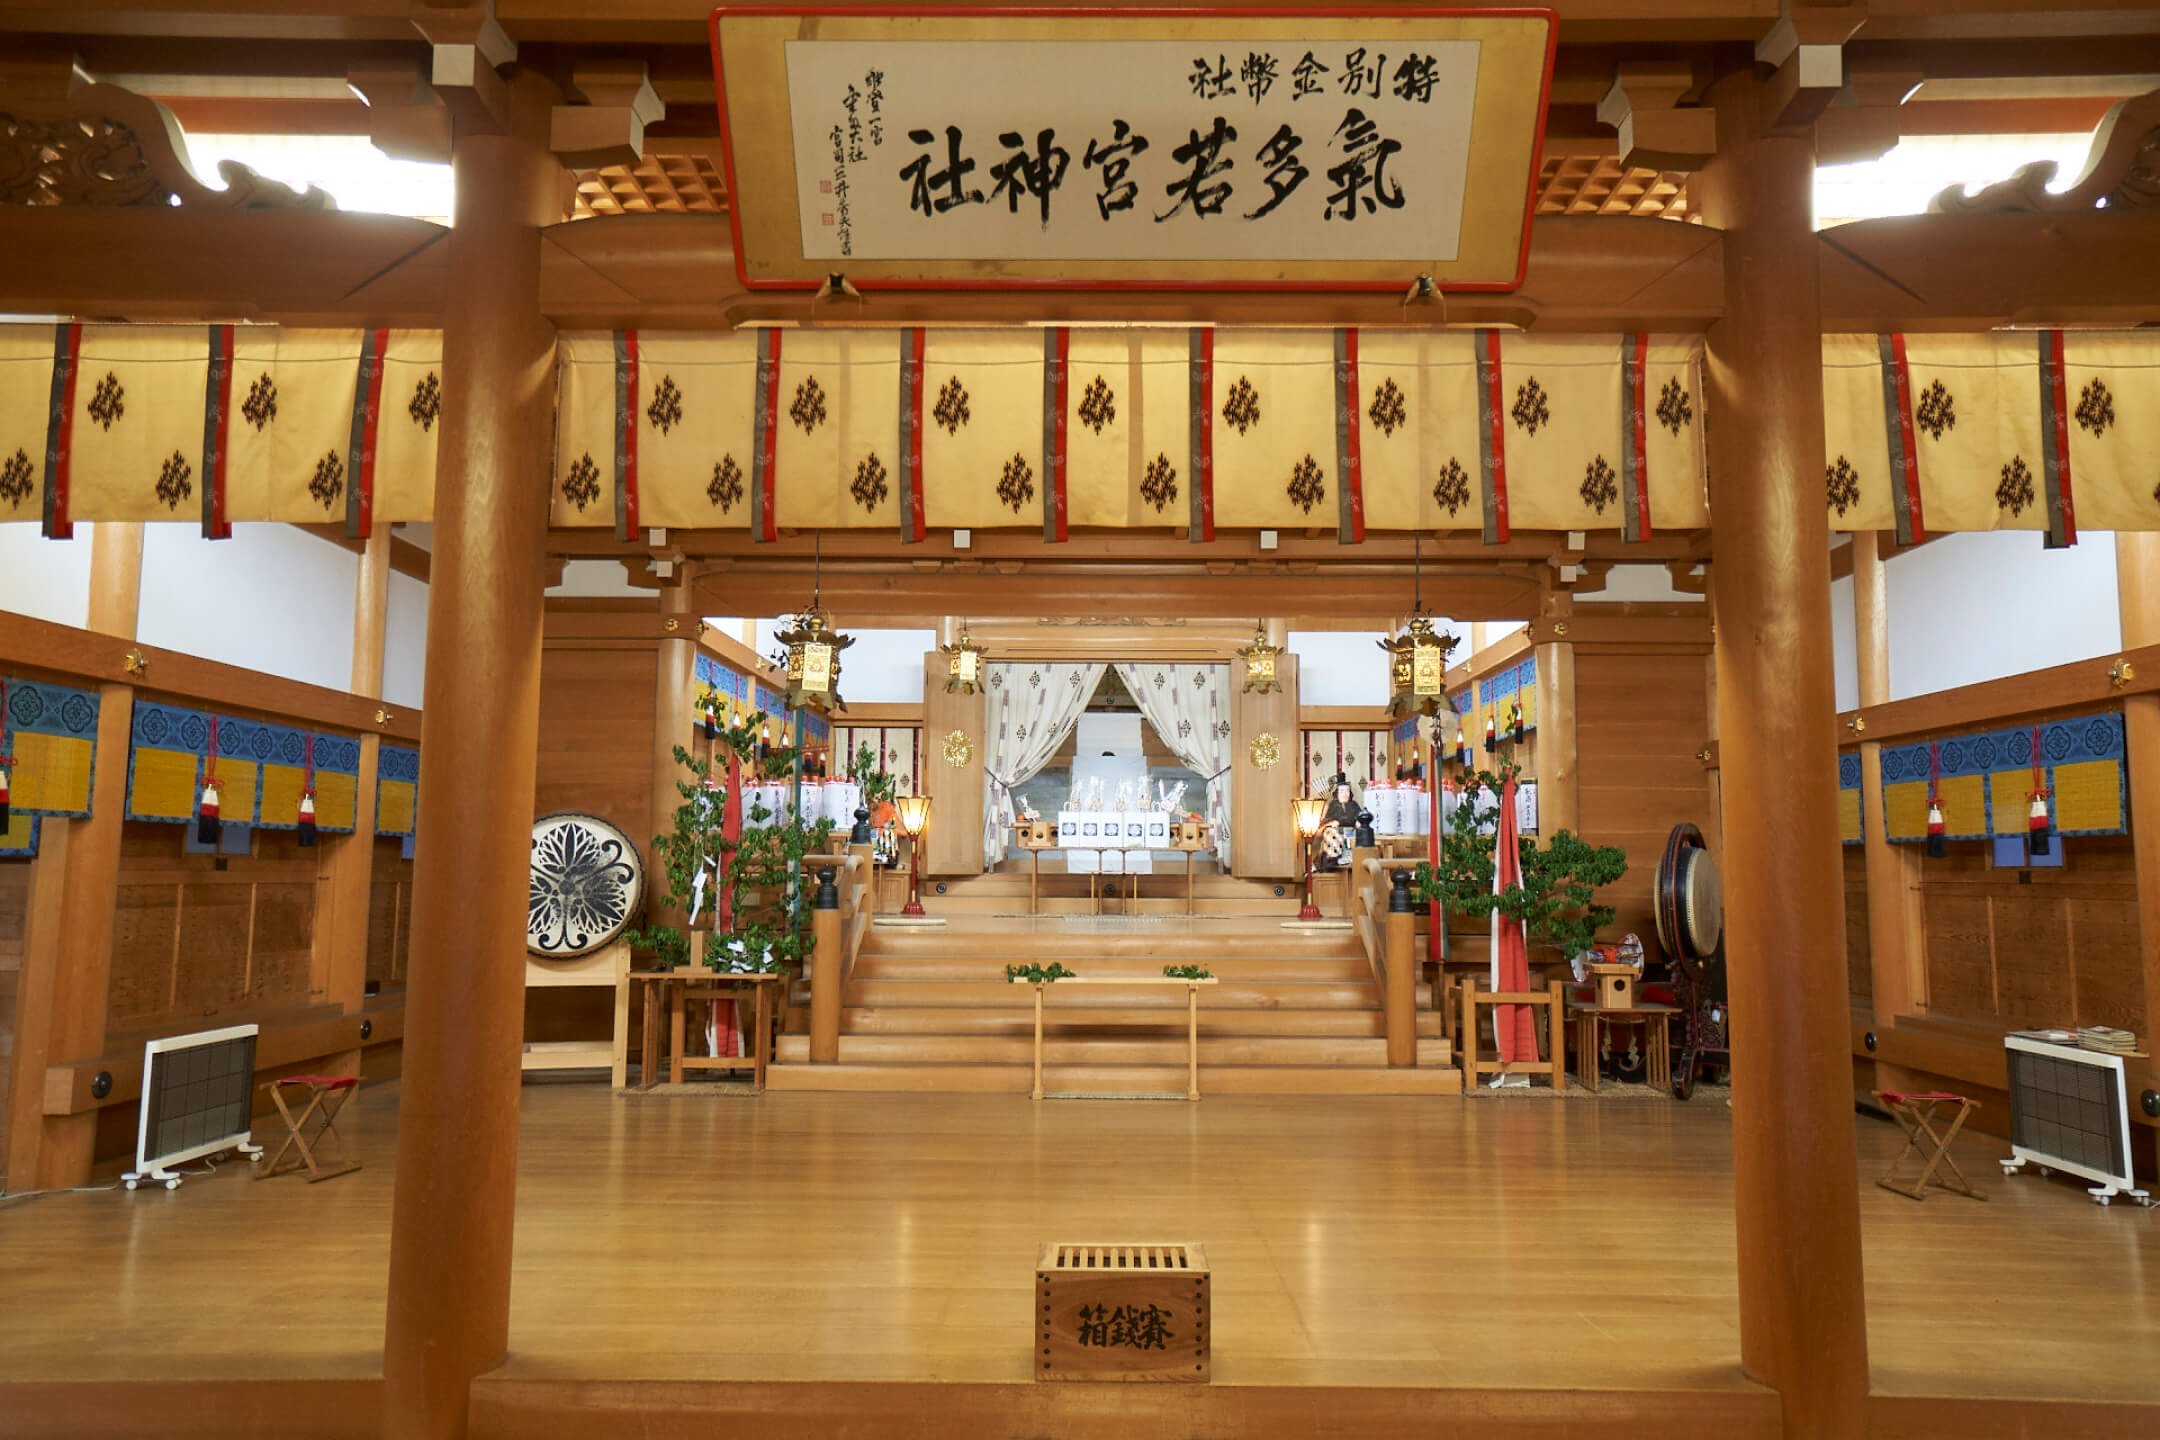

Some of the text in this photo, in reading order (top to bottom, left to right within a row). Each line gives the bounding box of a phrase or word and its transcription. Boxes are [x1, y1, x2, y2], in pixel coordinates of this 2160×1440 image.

[899, 107, 1406, 232] 氣多若宮神社
